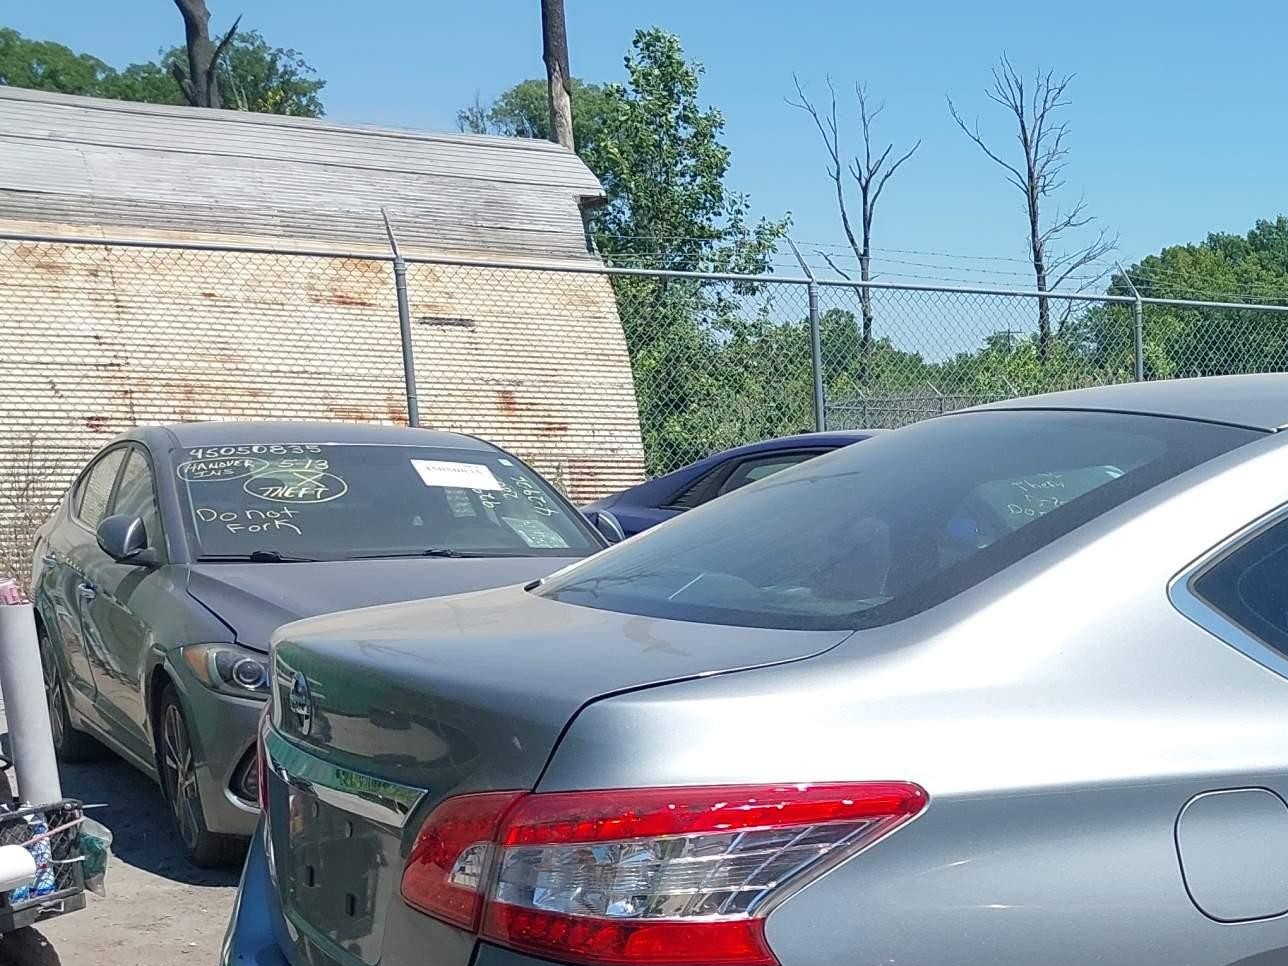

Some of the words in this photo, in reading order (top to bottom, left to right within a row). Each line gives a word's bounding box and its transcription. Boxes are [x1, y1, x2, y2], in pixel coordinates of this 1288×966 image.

[189, 445, 322, 459] 45050835
[278, 459, 329, 470] 5-13
[259, 486, 330, 499] THEFT
[196, 508, 238, 521] Do
[245, 506, 300, 521] not
